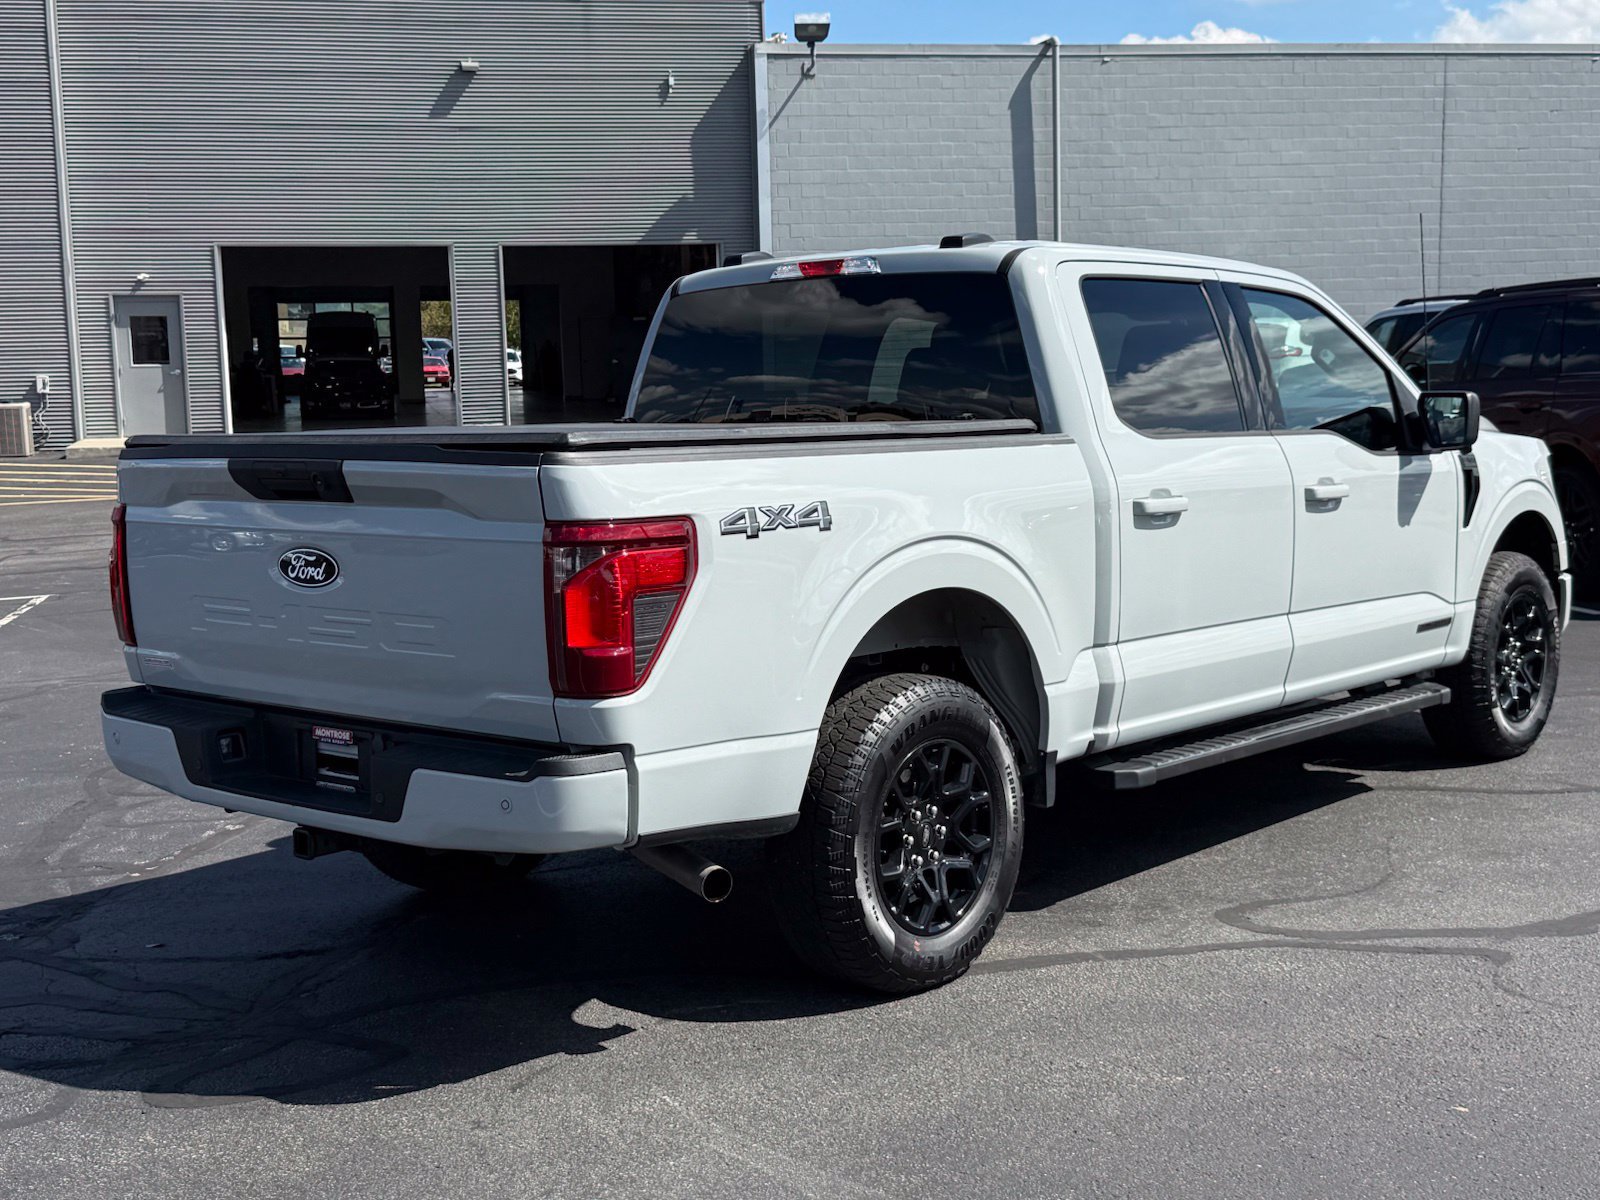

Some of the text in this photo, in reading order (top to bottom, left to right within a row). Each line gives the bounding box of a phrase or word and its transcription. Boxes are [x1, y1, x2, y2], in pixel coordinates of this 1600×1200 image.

[288, 553, 327, 581] Ford
[315, 728, 351, 740] MONTROSE
[1005, 763, 1019, 834] TERRITORY
